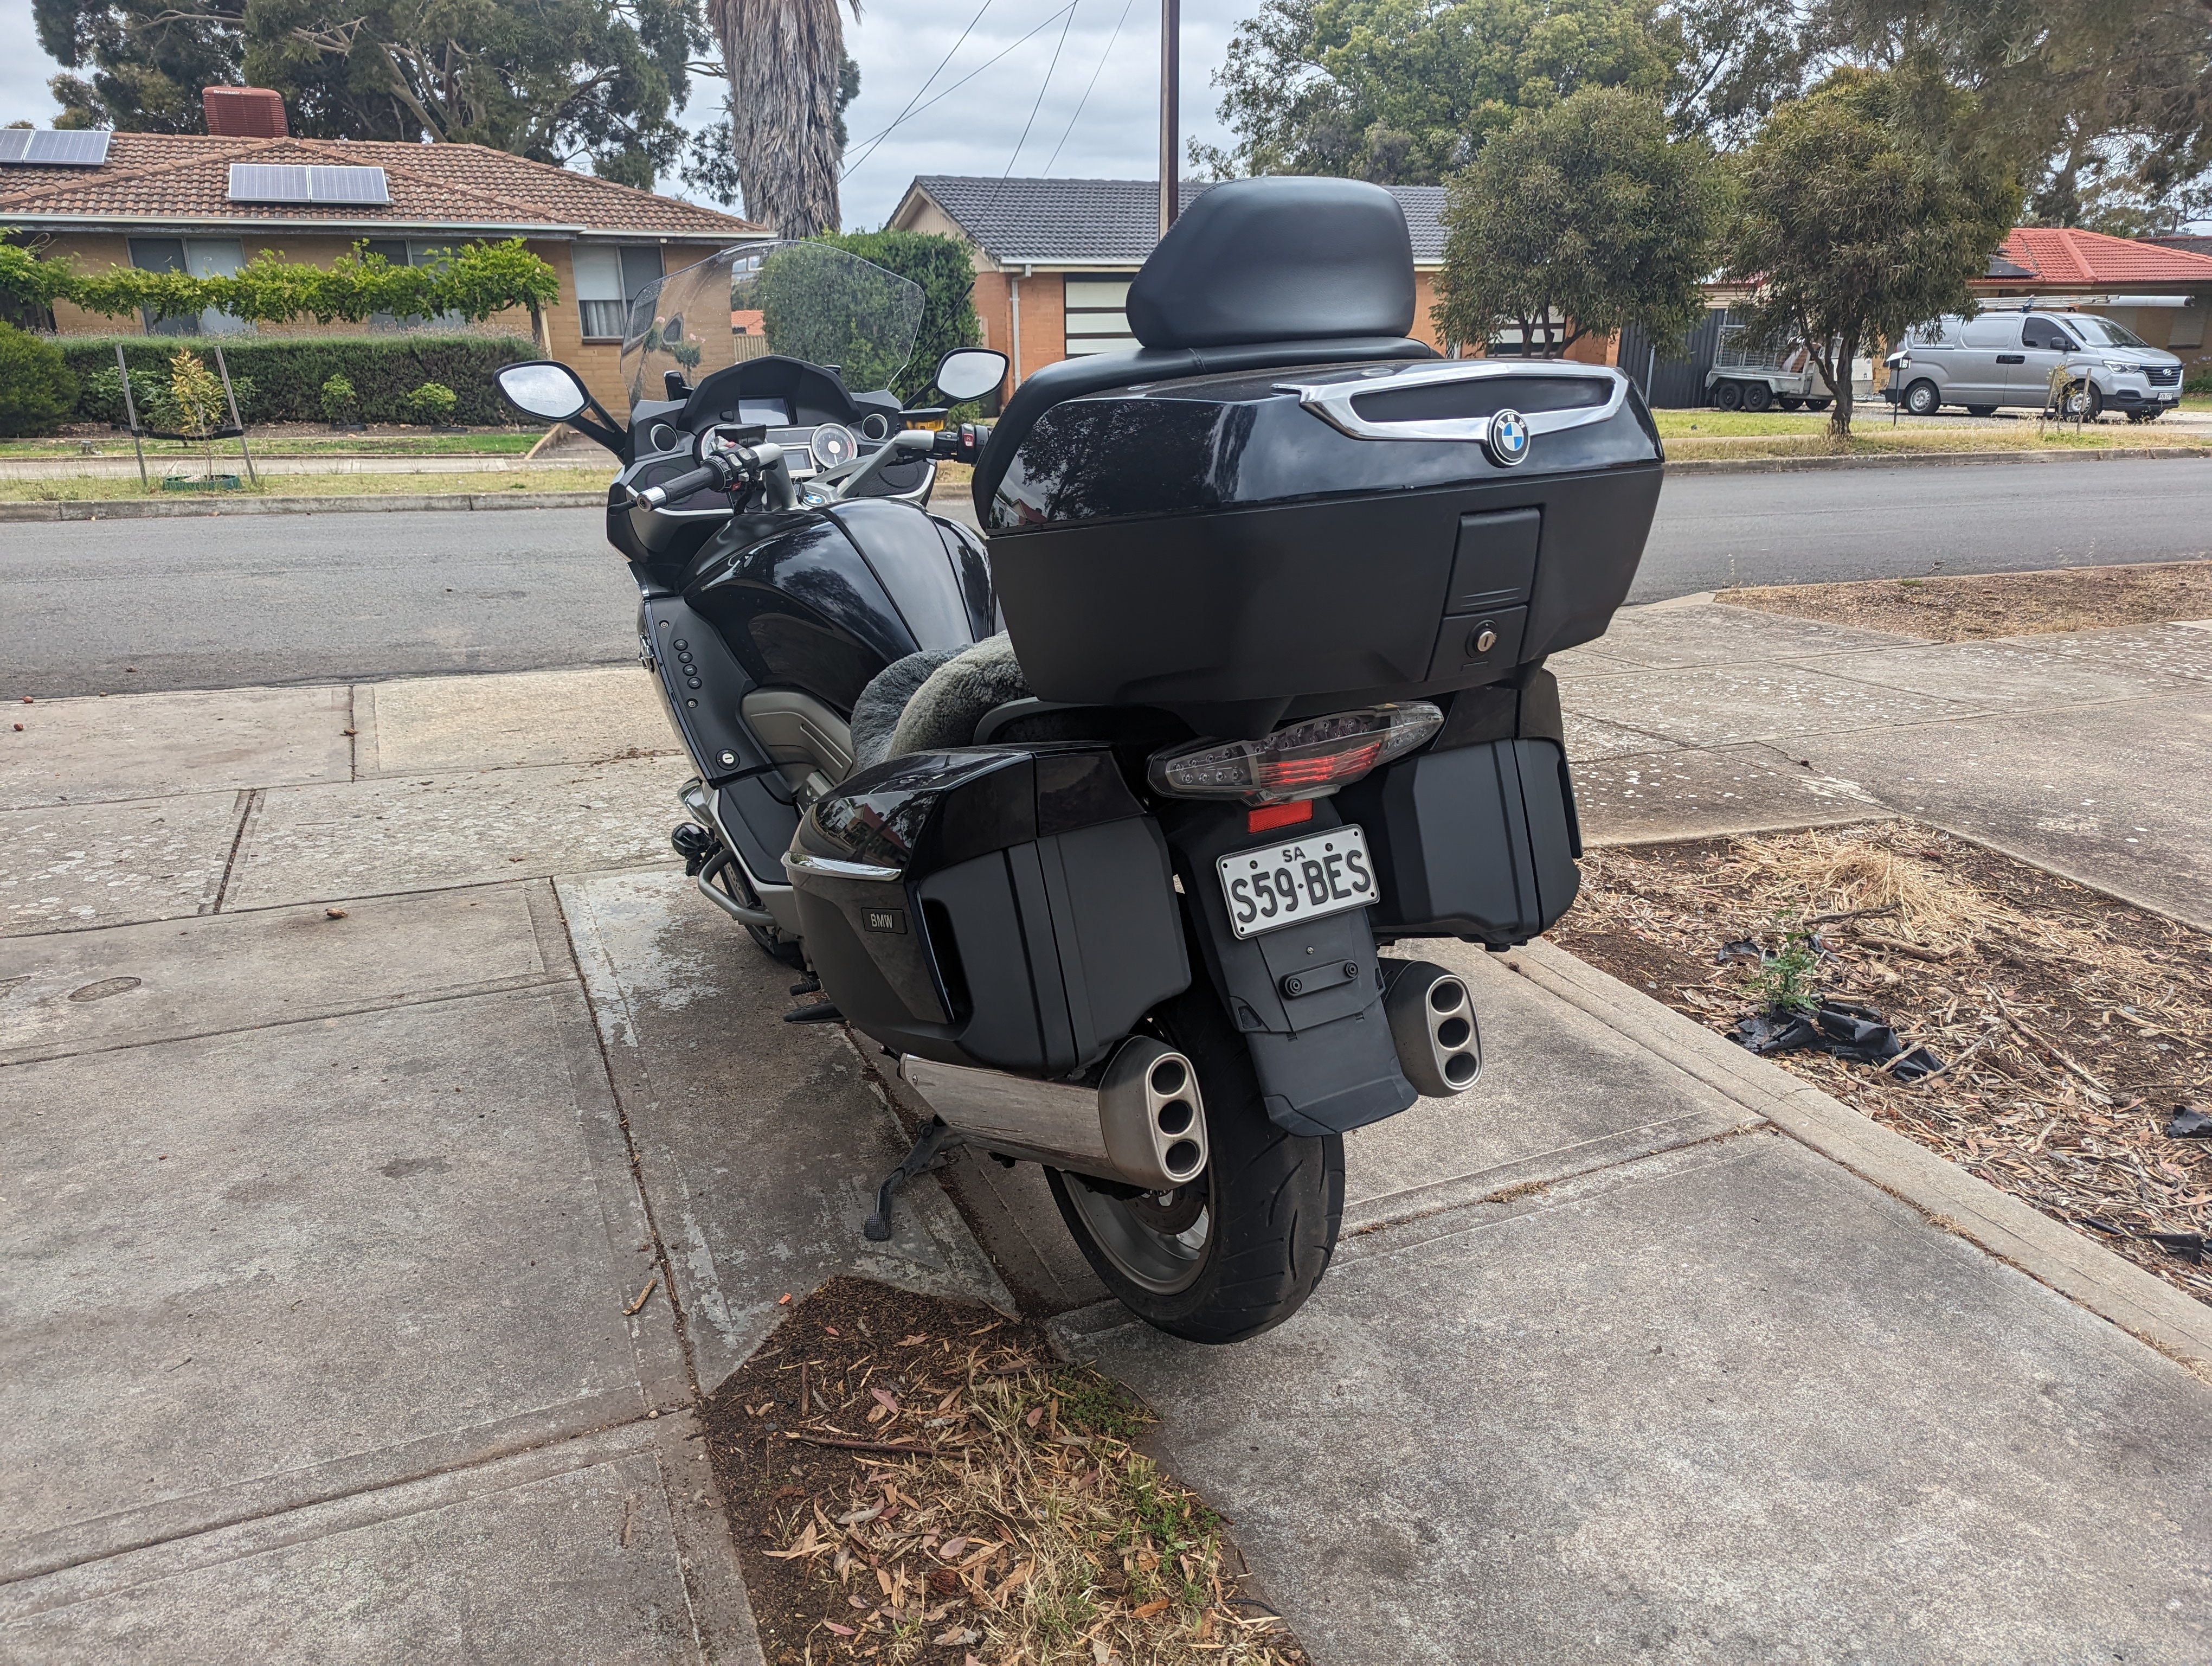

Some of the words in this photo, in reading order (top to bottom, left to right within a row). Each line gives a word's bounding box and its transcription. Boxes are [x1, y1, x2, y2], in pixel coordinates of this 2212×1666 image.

[1497, 414, 1526, 430] BMW
[1282, 847, 1306, 862] SA
[870, 913, 892, 928] BMW
